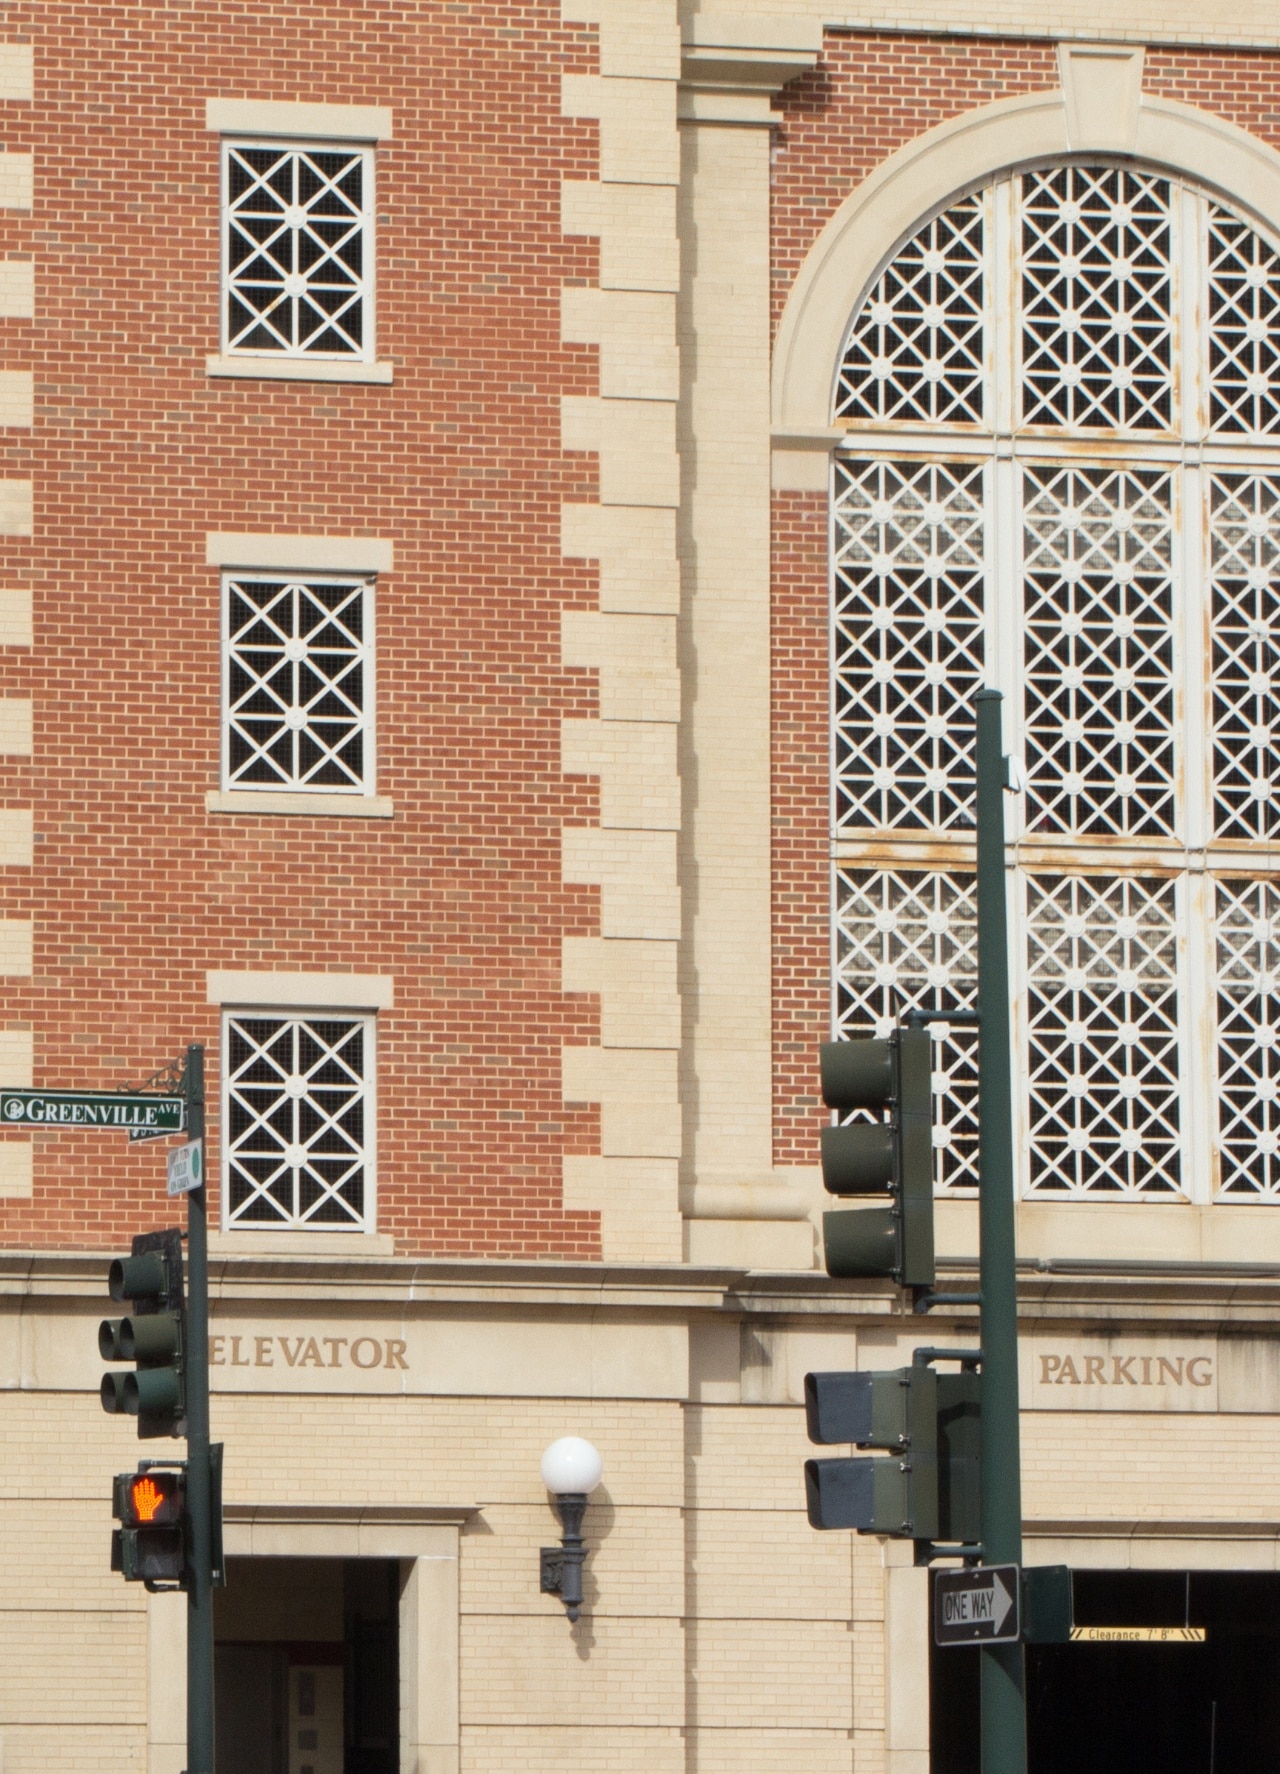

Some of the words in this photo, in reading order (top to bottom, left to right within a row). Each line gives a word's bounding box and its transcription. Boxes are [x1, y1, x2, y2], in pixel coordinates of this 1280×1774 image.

[26, 1098, 158, 1125] GREENVILLE
[158, 1103, 180, 1114] AVE
[208, 1335, 410, 1369] ELEVATOR
[1039, 1355, 1212, 1386] PARKING
[945, 1593, 968, 1621] ONE
[972, 1590, 994, 1618] WAY
[1088, 1628, 1141, 1640] Clearance
